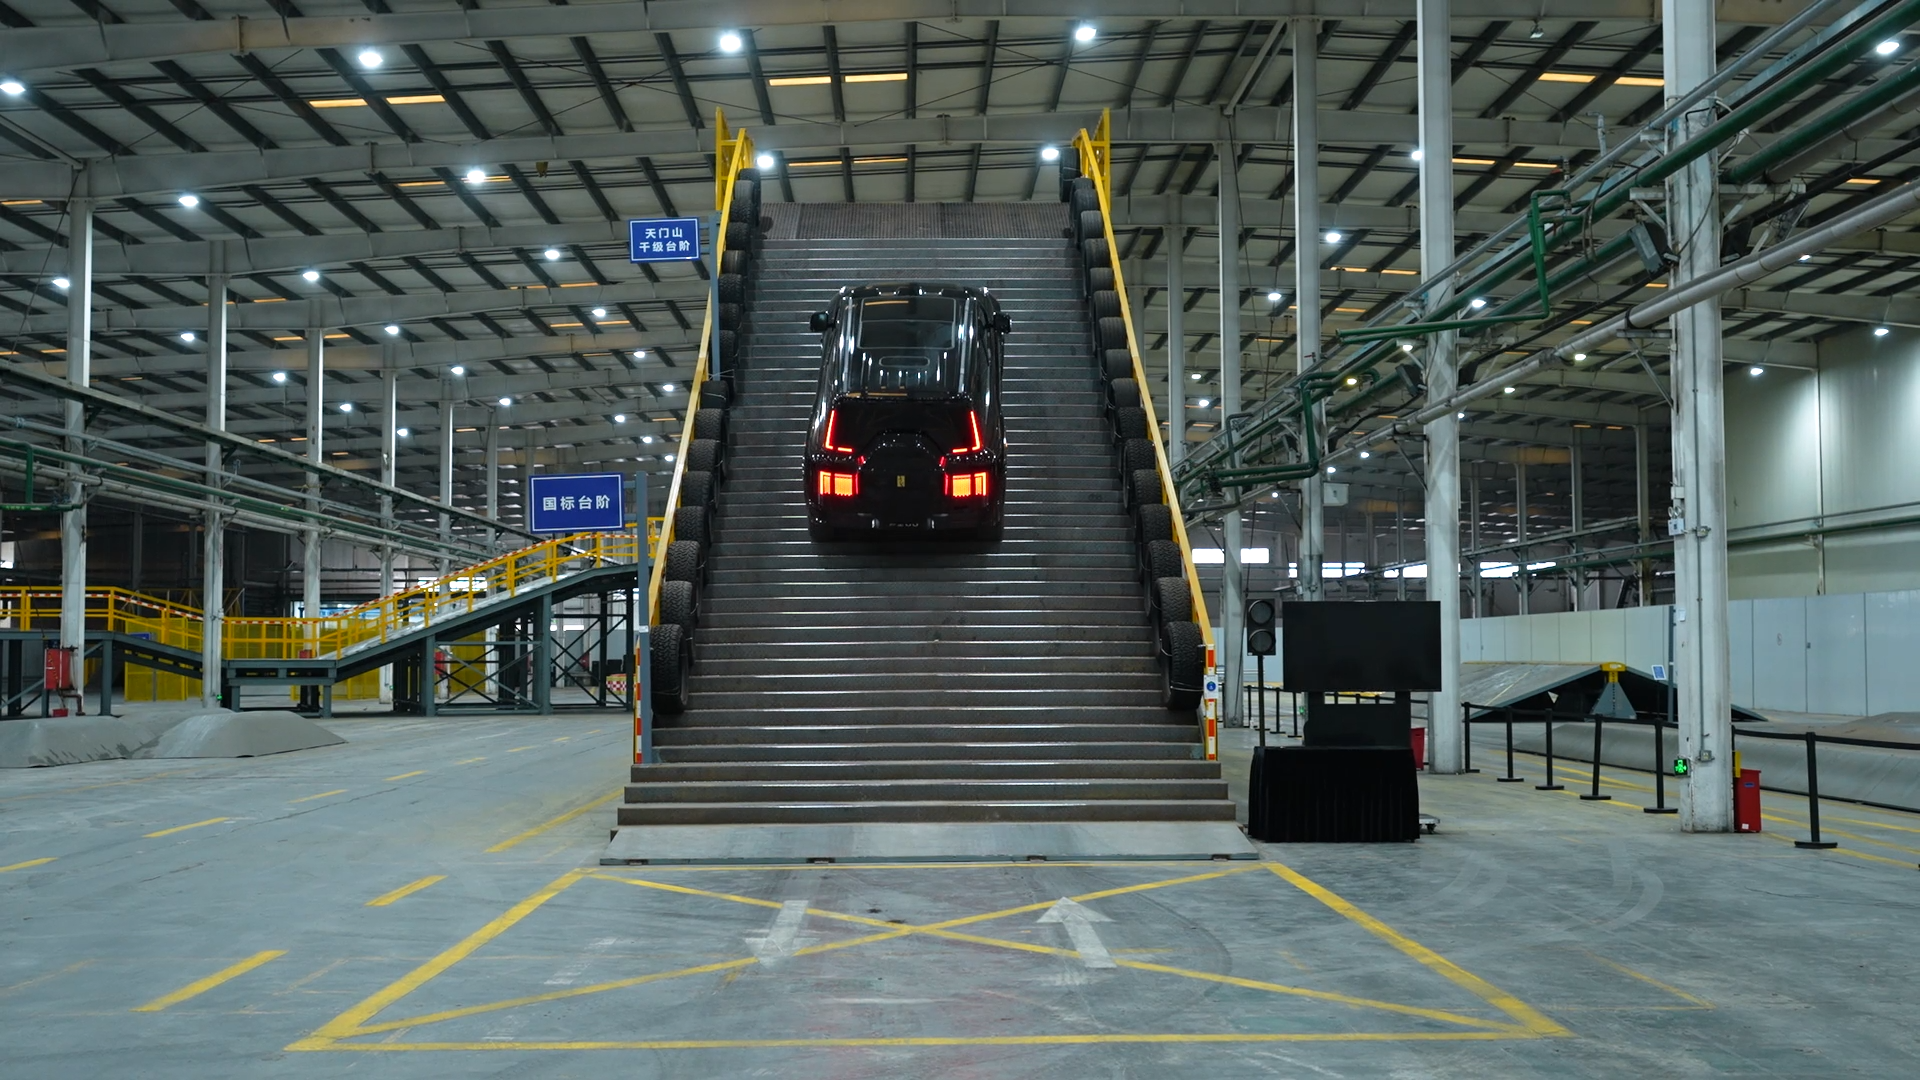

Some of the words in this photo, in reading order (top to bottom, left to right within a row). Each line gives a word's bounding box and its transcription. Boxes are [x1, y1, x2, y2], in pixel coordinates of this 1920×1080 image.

[645, 227, 682, 239] 天门山
[639, 240, 690, 253] 千级台阶
[543, 494, 610, 511] 国标台阶
